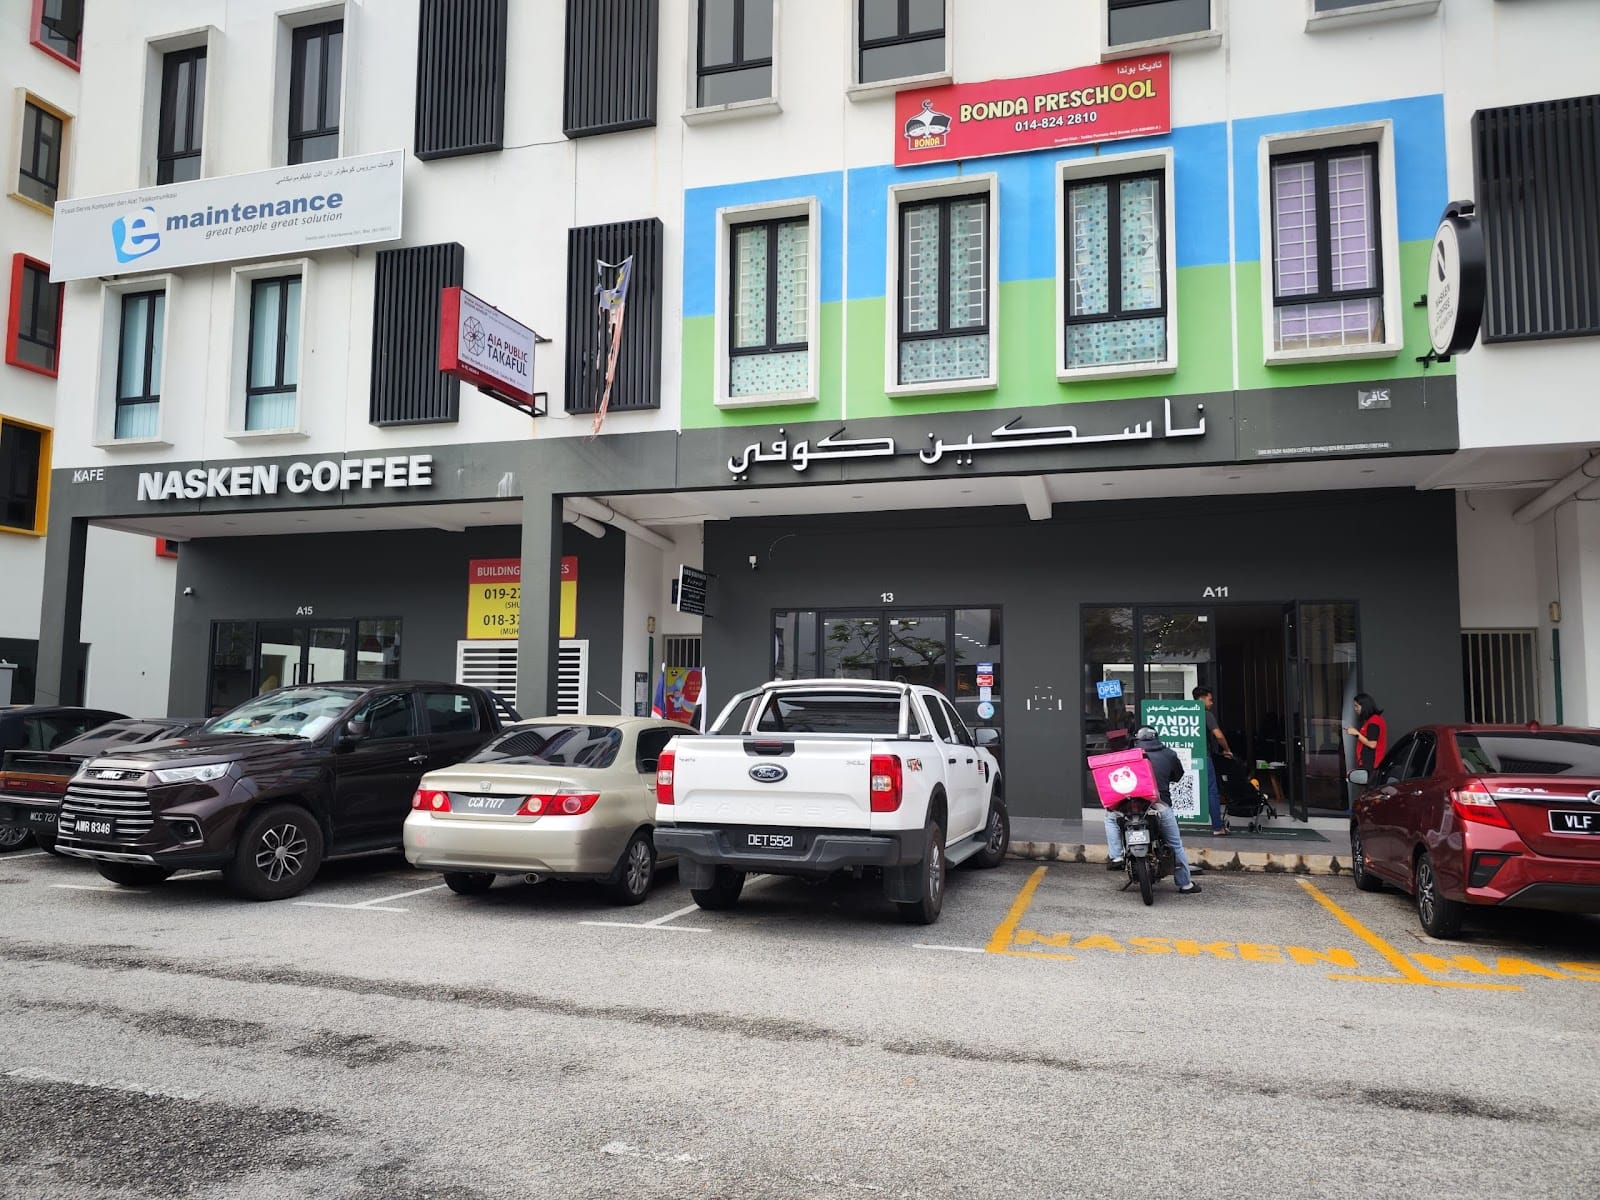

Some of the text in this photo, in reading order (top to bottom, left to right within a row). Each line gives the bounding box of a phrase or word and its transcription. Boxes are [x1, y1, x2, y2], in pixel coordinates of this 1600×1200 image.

[959, 79, 1156, 123] BONDA PRESCHOOL
[1015, 111, 1097, 132] 014-824 2810
[914, 137, 940, 147] BONDA
[166, 192, 343, 231] maintenance
[205, 212, 342, 240] great people great solution
[488, 333, 528, 363] AIA PUBLIC
[487, 344, 528, 377] TAKAFUL
[727, 397, 1206, 482] ناسكين كوفي
[73, 468, 104, 483] KAFE
[137, 454, 433, 501] NASKEN COFFEE
[477, 566, 520, 577] BUILDING
[880, 592, 894, 603] 13
[1202, 586, 1229, 598] A11
[296, 606, 313, 616] A15
[1099, 684, 1121, 696] OPEN
[1146, 715, 1200, 726] PANDU
[91, 822, 110, 835] 8346
[1564, 815, 1592, 829] VLF
[769, 834, 794, 847] 5521
[1013, 929, 1361, 968] NASKEN
